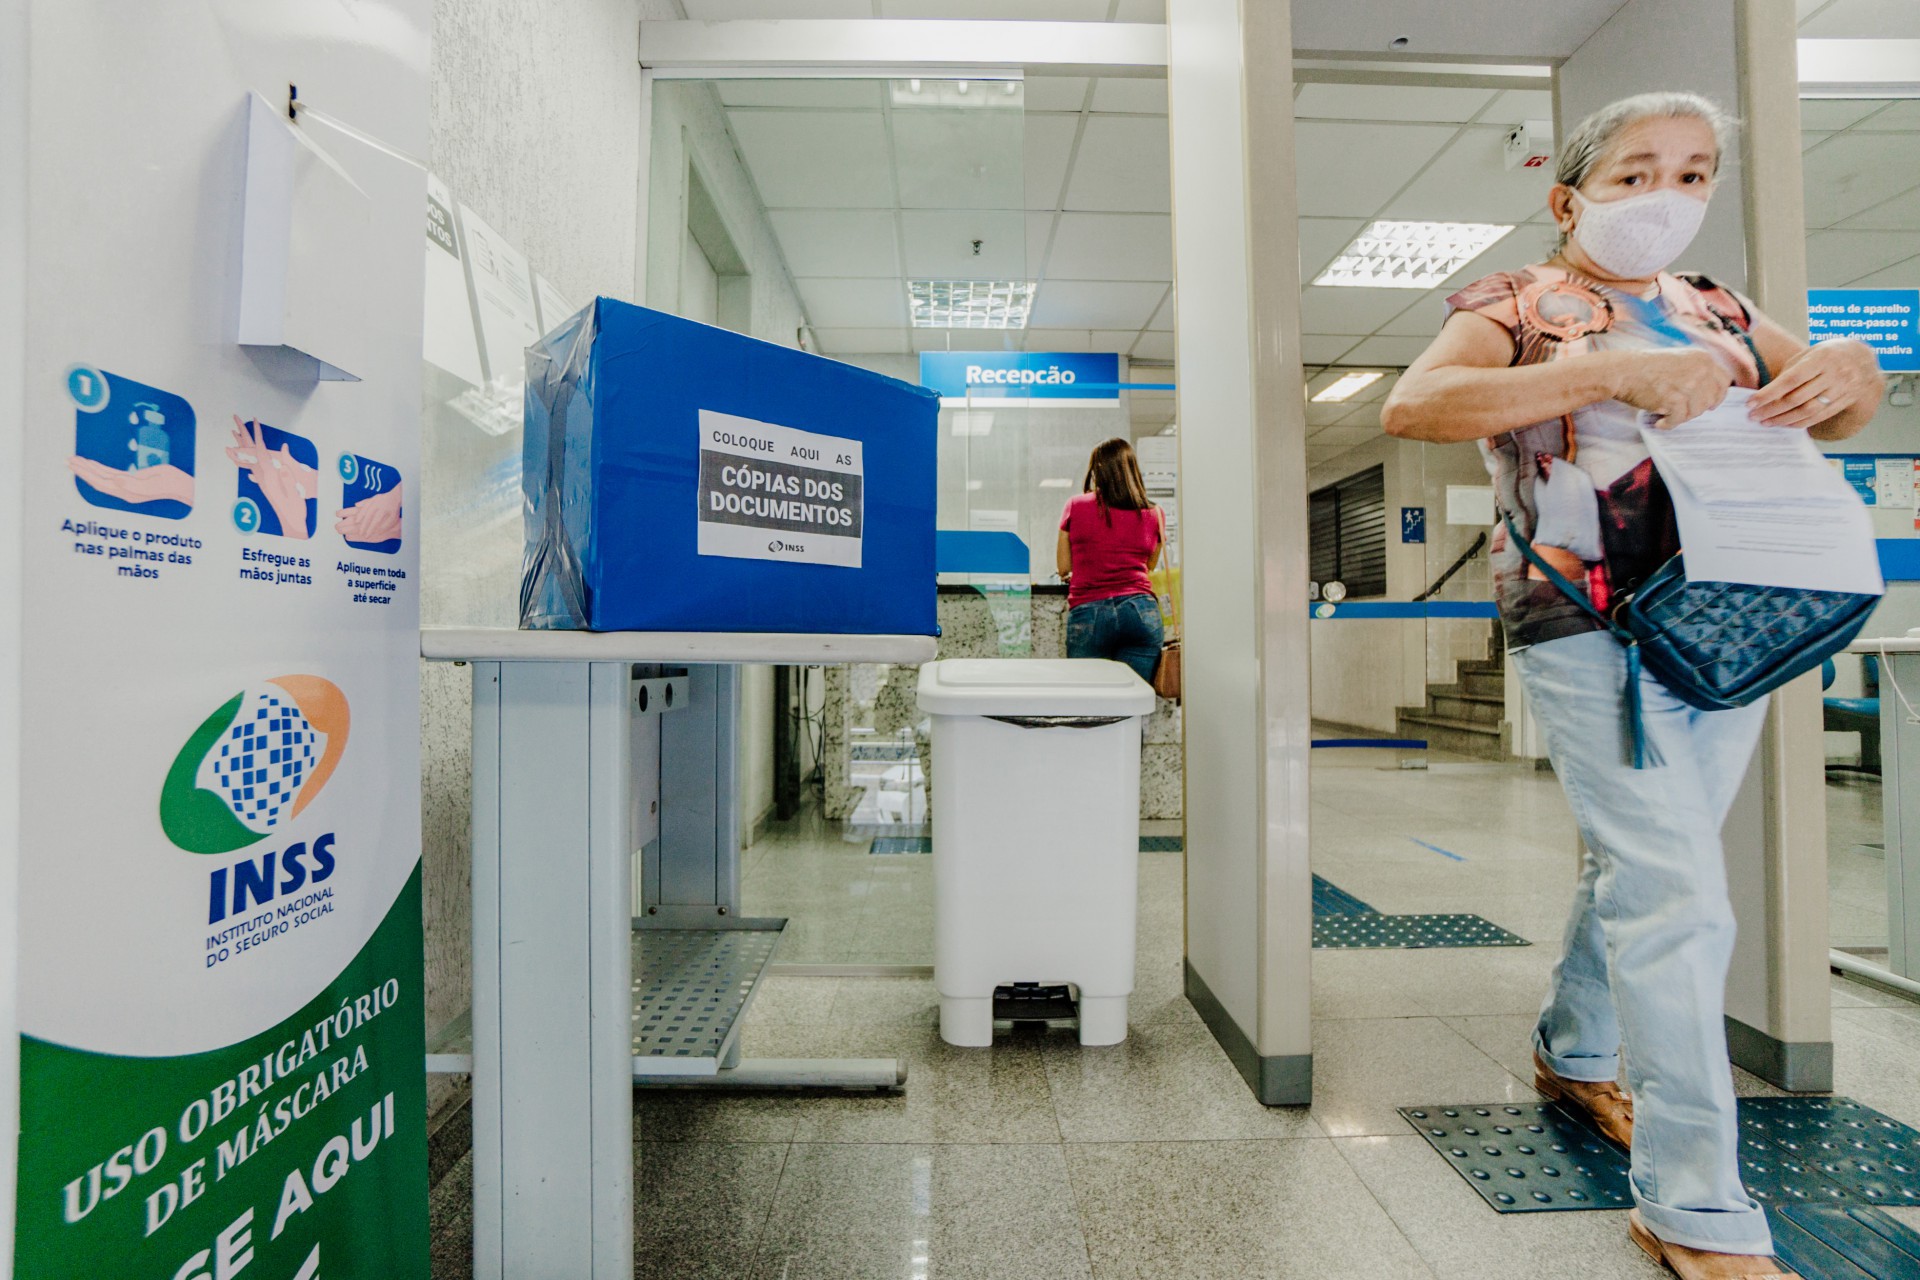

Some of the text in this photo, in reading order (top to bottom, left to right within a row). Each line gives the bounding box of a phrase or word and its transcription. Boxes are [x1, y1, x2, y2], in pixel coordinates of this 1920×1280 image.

[1847, 304, 1861, 314] de
[1863, 304, 1910, 315] aparelho
[1830, 319, 1899, 329] marca-passo
[1901, 319, 1908, 327] e
[1847, 331, 1883, 340] devem
[78, 375, 92, 397] 1
[713, 430, 852, 465] COLOQUE AQUI AS
[344, 458, 353, 474] 3
[722, 464, 843, 501] CÓPIAS DOS
[241, 508, 252, 524] 2
[710, 491, 852, 526] DOCUMENTOS
[61, 519, 202, 549] Aplique o produto
[75, 542, 192, 565] nas palmas das
[242, 547, 311, 568] Esfregue as
[785, 544, 804, 552] INSS
[118, 564, 159, 579] mãos
[240, 567, 312, 585] mãos juntas
[336, 561, 406, 579] Aplique em toda
[347, 579, 353, 587] a
[353, 592, 391, 605] até secar
[208, 832, 336, 925] INSS
[206, 886, 334, 950] INSTITUTO NACIONAL
[206, 901, 334, 968] DO SEGURO SOCIAL
[63, 977, 399, 1224] USO OBRIGATÓRIO
[144, 1044, 369, 1238] DE MÁSCARA
[270, 1091, 394, 1241] AQUI
